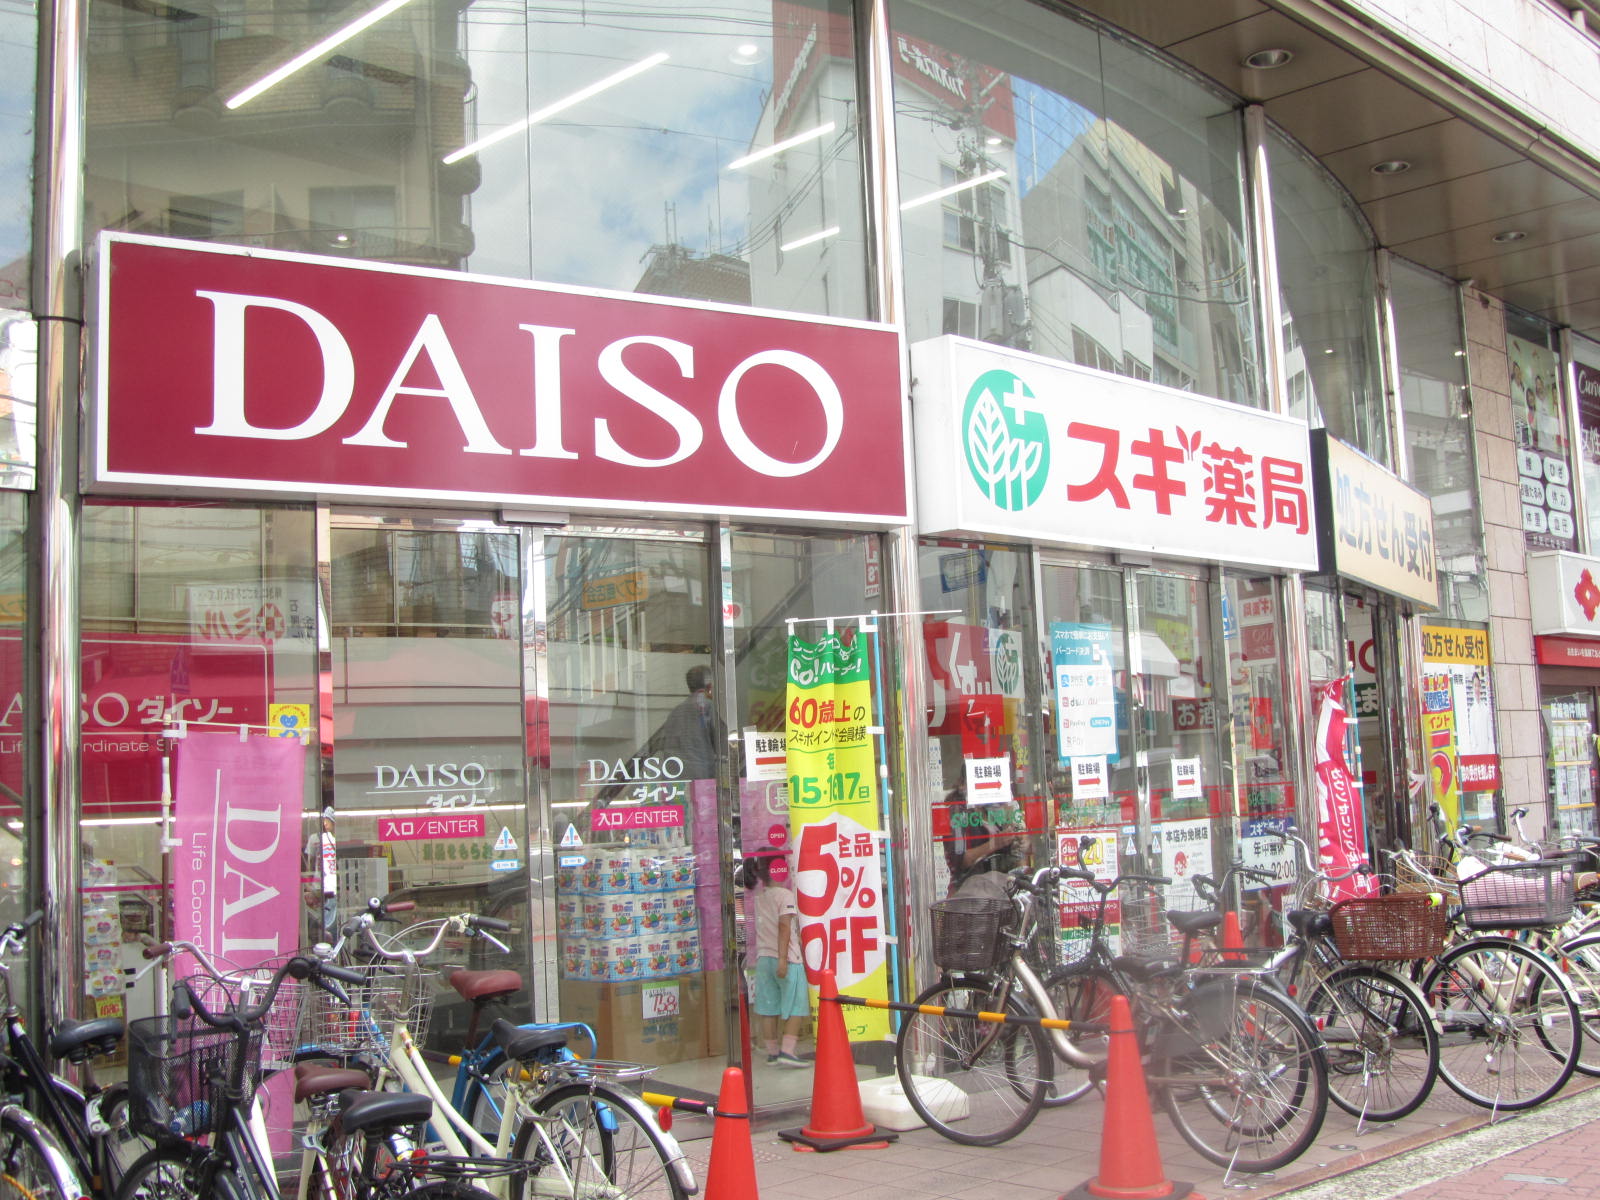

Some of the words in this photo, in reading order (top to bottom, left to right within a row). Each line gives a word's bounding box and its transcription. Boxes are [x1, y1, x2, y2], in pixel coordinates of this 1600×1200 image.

[193, 289, 845, 479] DAISO
[1067, 421, 1309, 535] スギ薬局
[1336, 467, 1433, 582] 処方せん受付
[1422, 631, 1485, 660] 処方せん受付
[949, 632, 991, 695] くす
[375, 762, 486, 789] DAISO
[587, 757, 685, 782] DAISO
[974, 765, 1002, 779] 駐輪場
[1077, 761, 1101, 776] 駐輪場
[1176, 764, 1195, 776] 駐輪場
[633, 788, 685, 803] ダイソー
[951, 811, 983, 829] SUGI
[1165, 826, 1208, 843] 本店为免税店
[192, 832, 207, 871] Life
[801, 915, 878, 986] OFF
